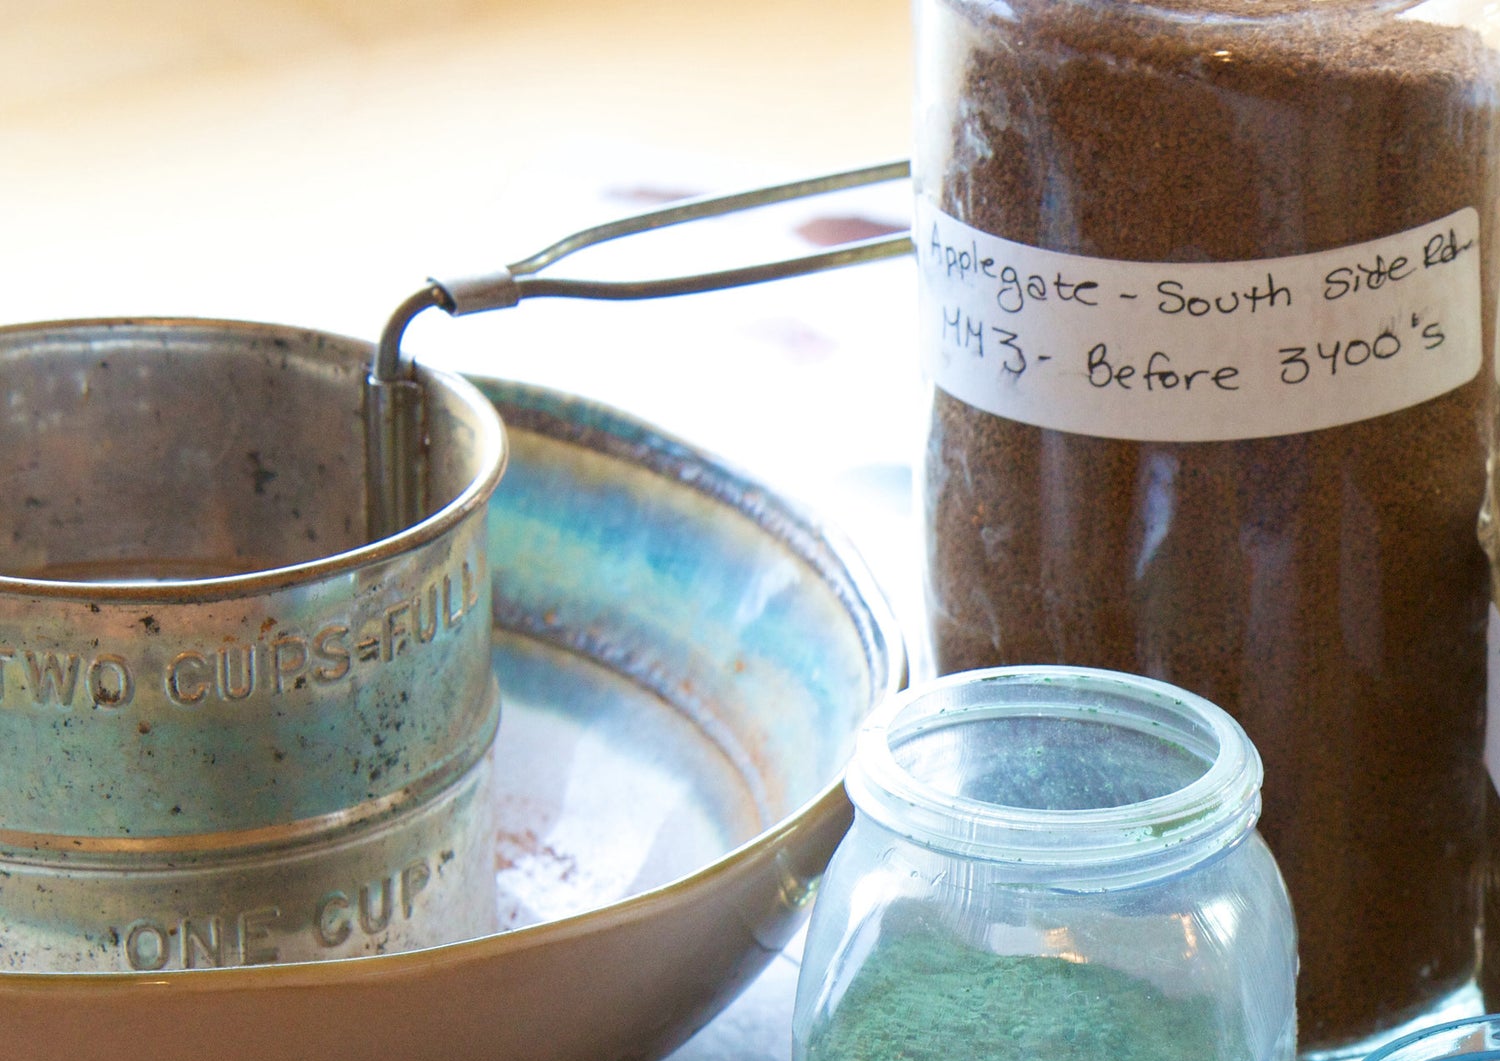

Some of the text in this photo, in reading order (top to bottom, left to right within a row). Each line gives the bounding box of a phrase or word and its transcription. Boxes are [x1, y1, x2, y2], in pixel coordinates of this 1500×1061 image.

[930, 221, 1100, 313] Applegate
[1158, 273, 1292, 316] South
[1324, 252, 1409, 302] Side
[1087, 342, 1240, 391] Before
[1279, 312, 1446, 385] 3400's
[123, 904, 282, 973] ONE
